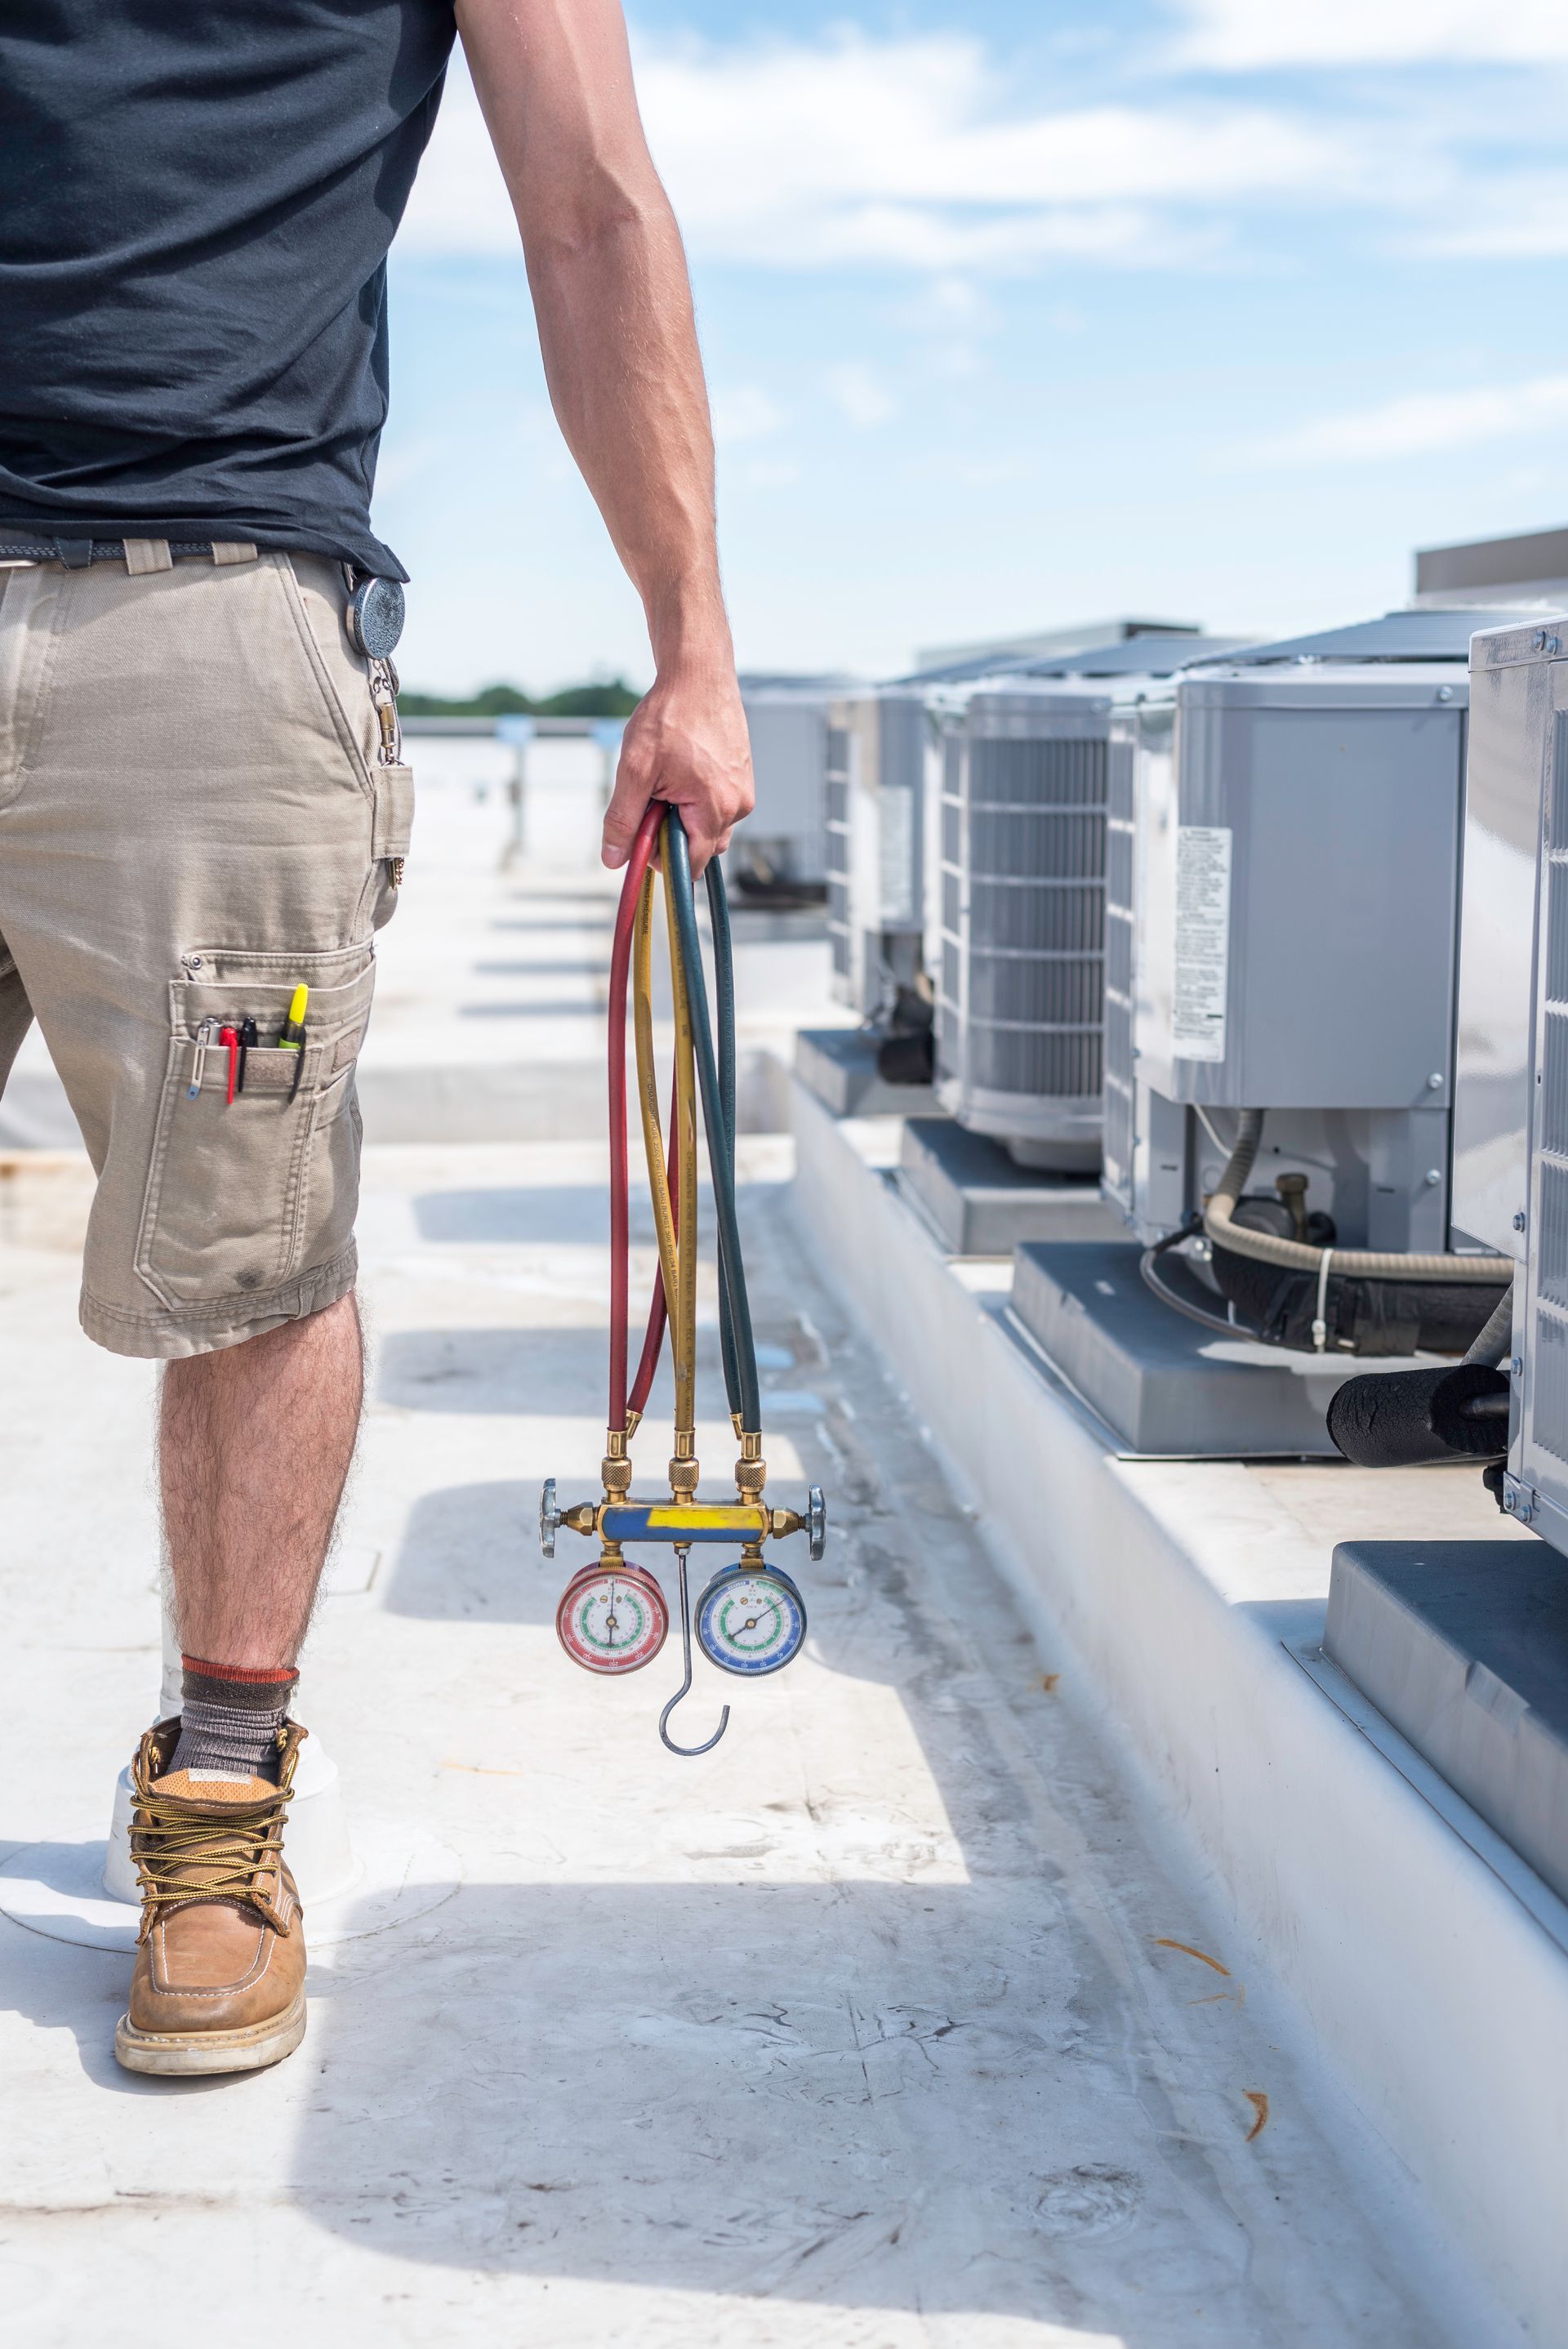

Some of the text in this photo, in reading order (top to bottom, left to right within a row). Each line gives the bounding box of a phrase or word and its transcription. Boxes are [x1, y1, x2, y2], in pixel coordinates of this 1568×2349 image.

[642, 900, 650, 935] PRESSURE
[647, 1084, 656, 1120] CHARGING
[662, 1206, 670, 1229] BURST
